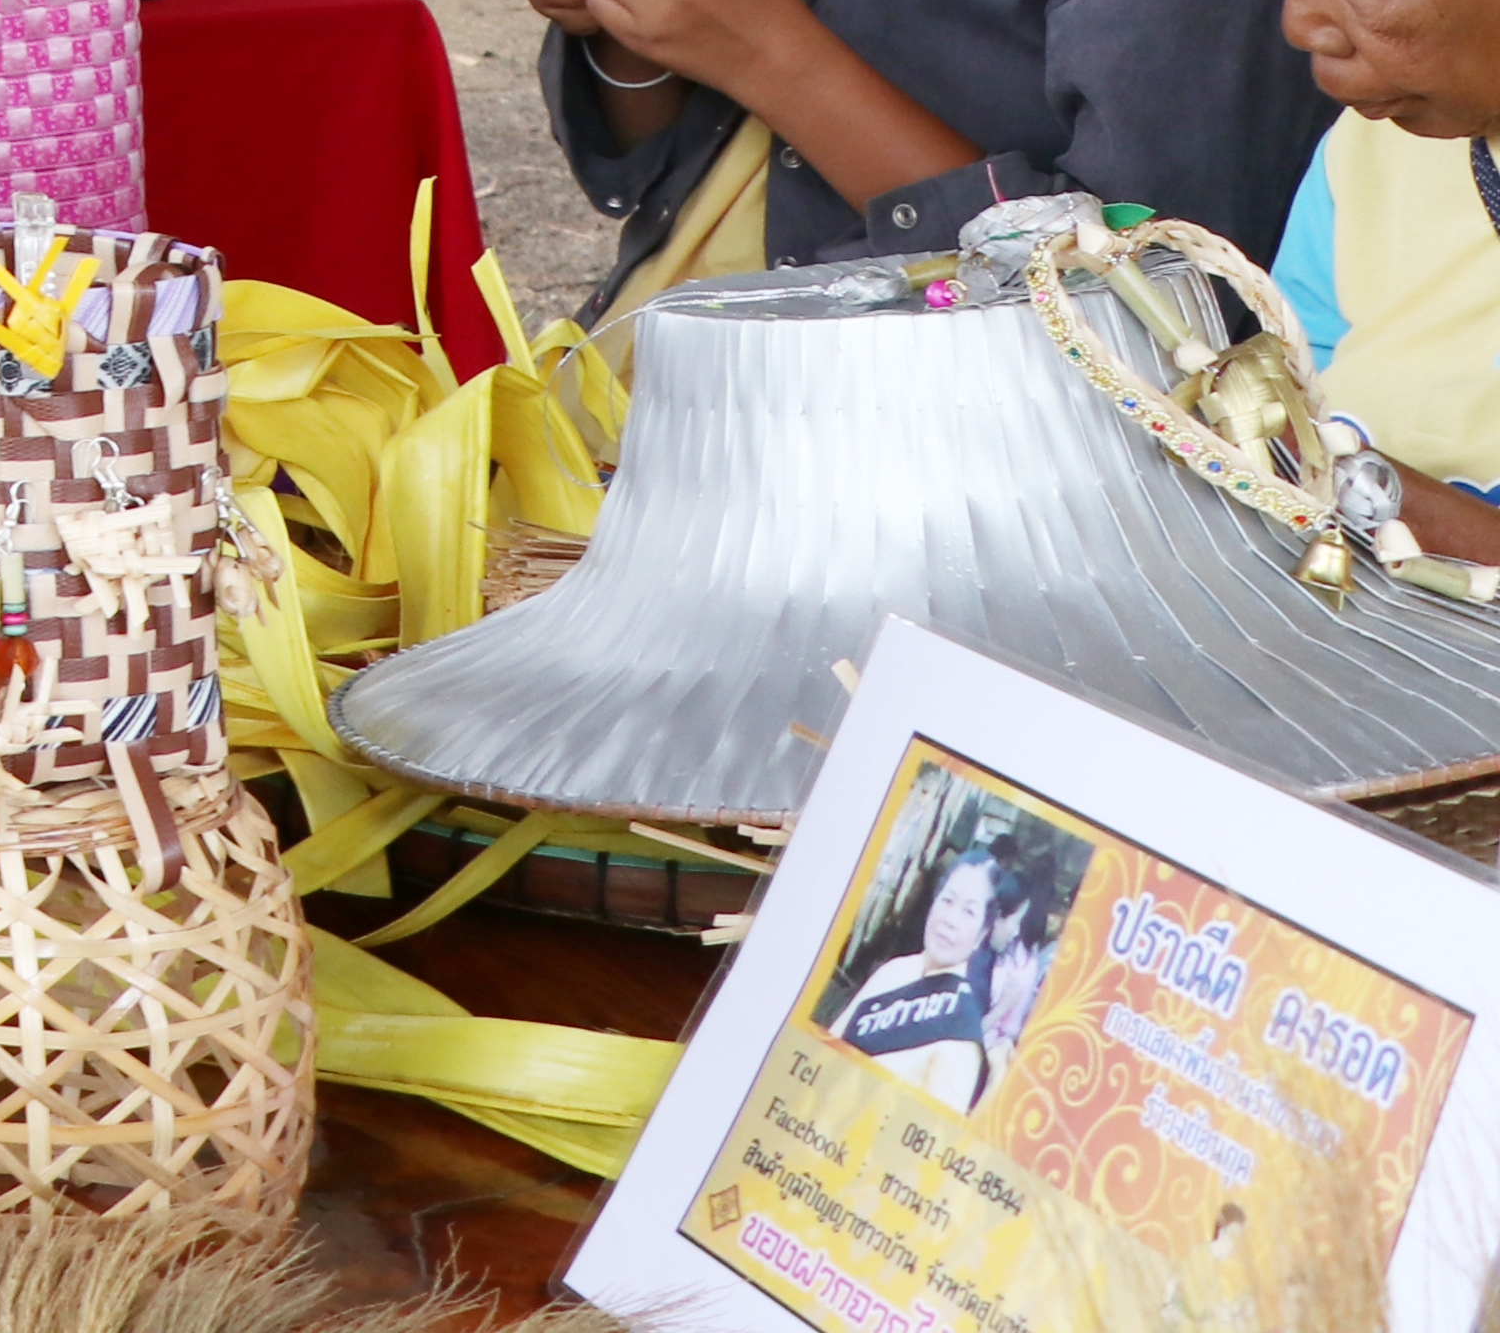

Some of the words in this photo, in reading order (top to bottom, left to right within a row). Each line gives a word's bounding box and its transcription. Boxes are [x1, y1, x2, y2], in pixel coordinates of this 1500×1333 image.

[1112, 896, 1244, 1015] ปราณีต
[1268, 991, 1403, 1104] คงรอด
[764, 1096, 849, 1167] Facebook
[880, 1172, 952, 1231] ชาวนารำ
[791, 1051, 822, 1086] Tel
[901, 1123, 1024, 1216] 081-042-8544
